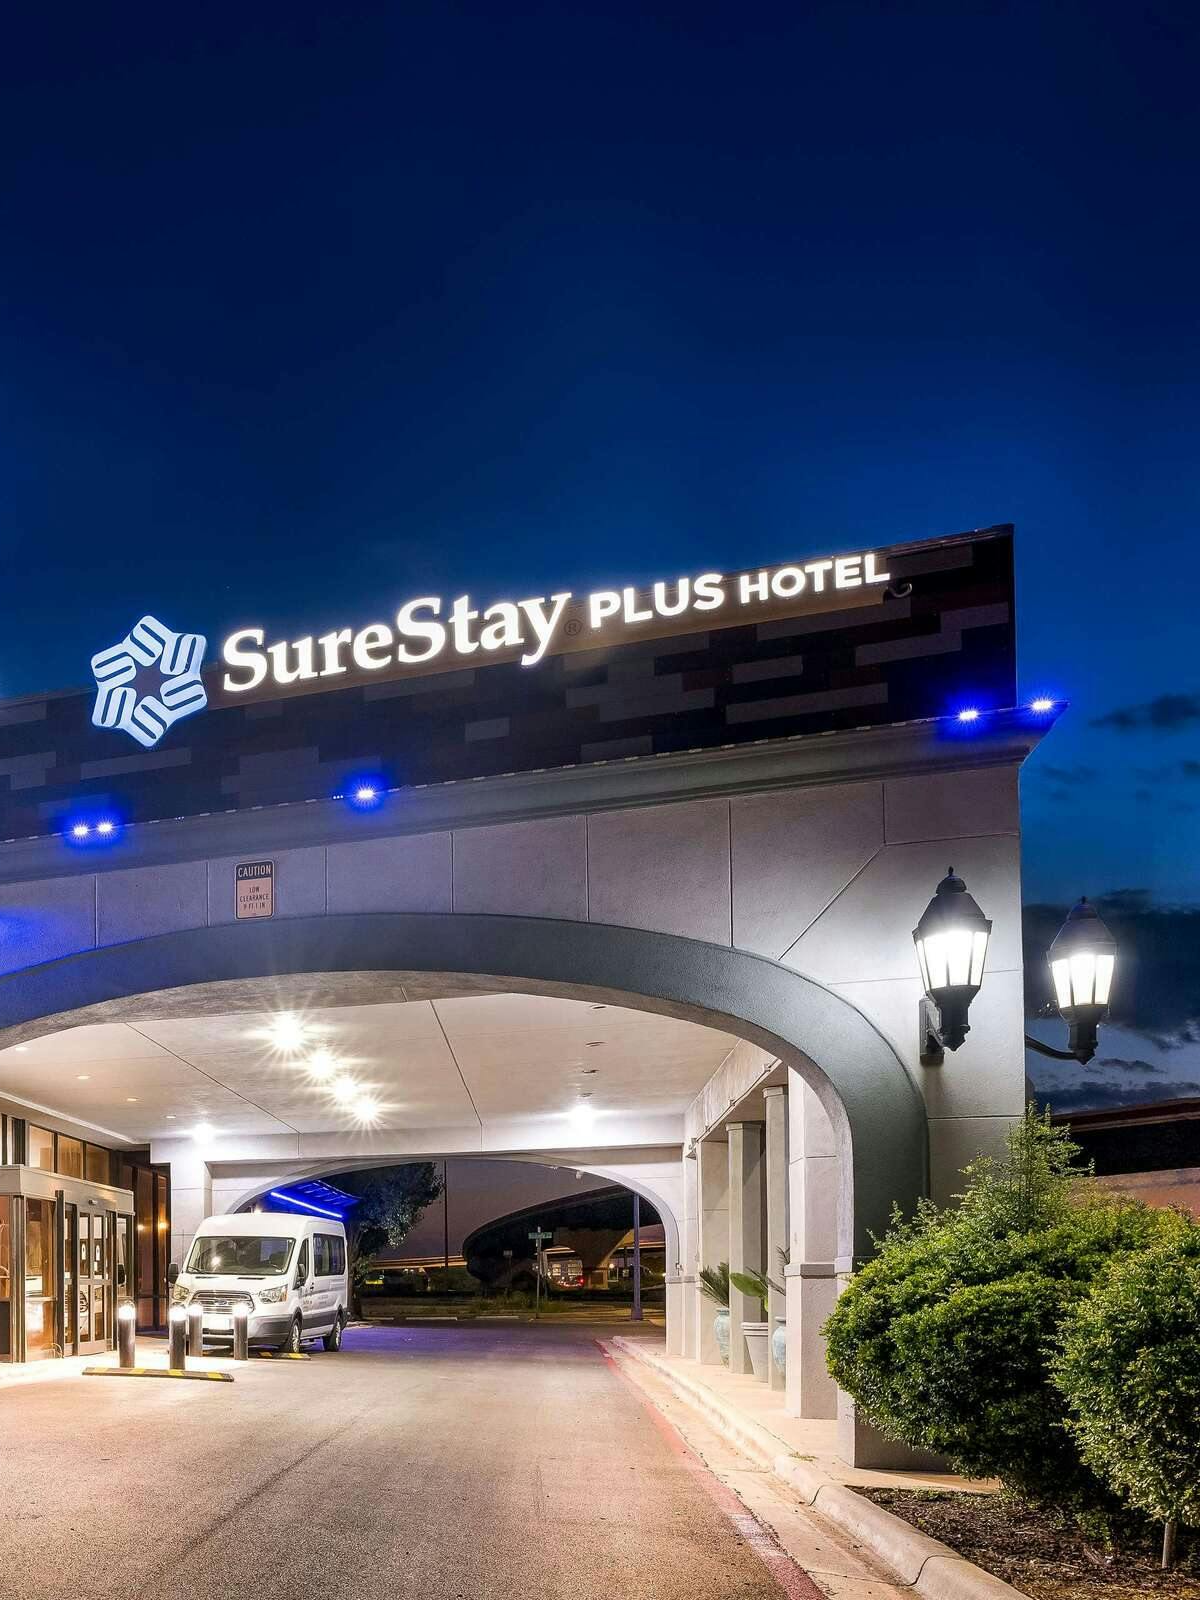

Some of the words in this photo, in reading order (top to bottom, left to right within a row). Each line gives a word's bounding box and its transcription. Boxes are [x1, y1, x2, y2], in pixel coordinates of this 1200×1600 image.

[589, 573, 725, 629] PLUS
[739, 553, 891, 604] HOTEL
[238, 864, 271, 878] CAUTION
[239, 894, 269, 903] CLEARANCE
